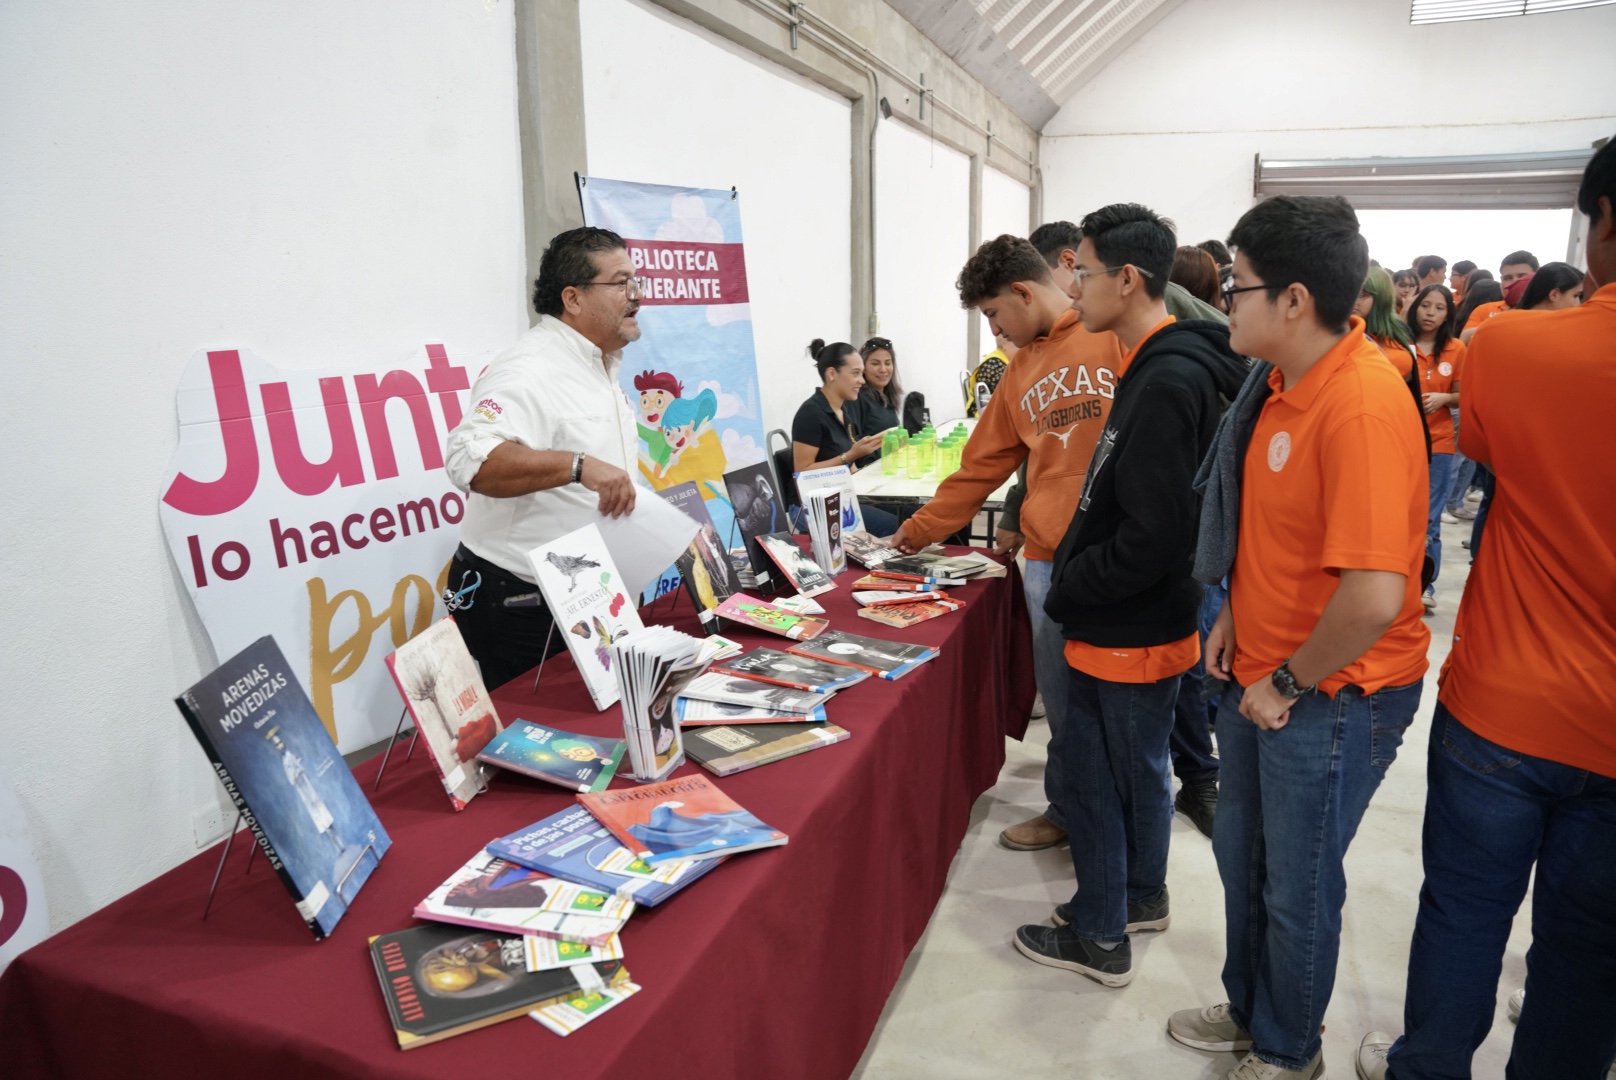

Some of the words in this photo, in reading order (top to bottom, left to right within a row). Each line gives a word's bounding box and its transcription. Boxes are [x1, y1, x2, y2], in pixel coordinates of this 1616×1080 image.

[626, 247, 719, 271] BLIOTECA
[632, 275, 722, 299] NERANTE
[1021, 364, 1115, 423] TEXAS
[163, 344, 490, 516] Junt
[1036, 399, 1102, 436] LONGHORNS
[679, 488, 698, 500] JULIETA
[187, 534, 251, 588] lo
[269, 491, 469, 569] hacemo
[219, 672, 288, 733] MOVEDIZAS
[221, 663, 270, 708] ARENAS
[213, 761, 245, 806] ARENAS
[241, 807, 283, 871] MOVEDIZAS
[511, 826, 557, 845] Pichas,
[521, 842, 533, 851] o
[530, 831, 565, 848] dejas
[391, 975, 425, 1022] ALFONSO
